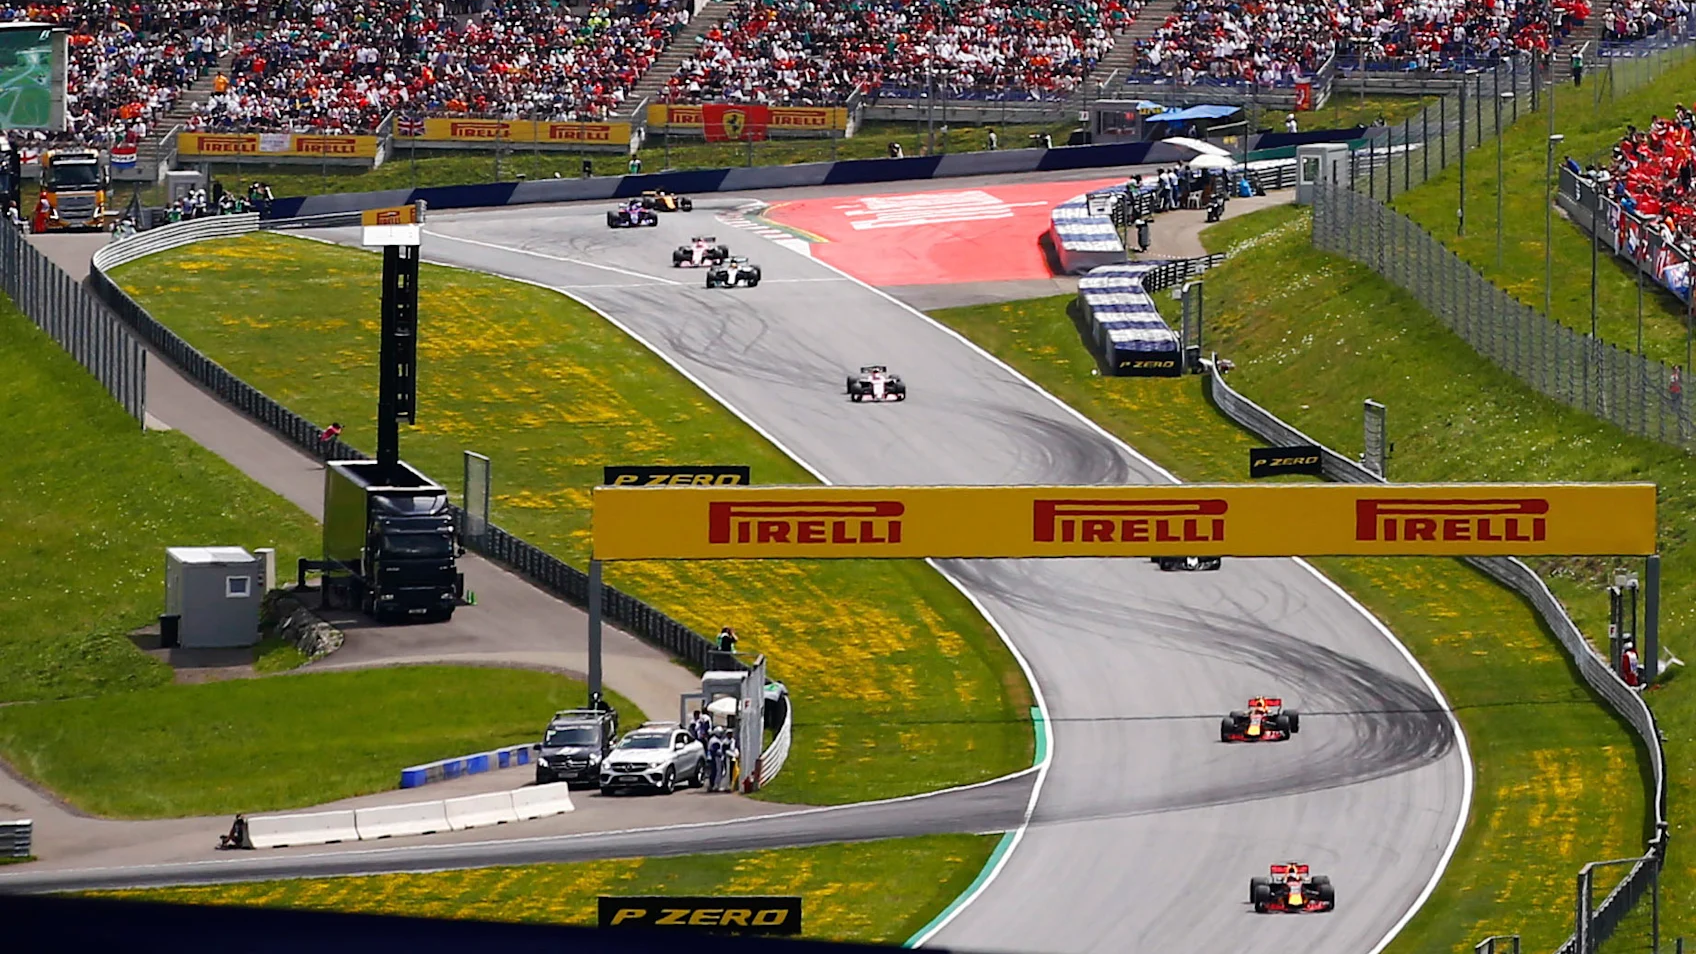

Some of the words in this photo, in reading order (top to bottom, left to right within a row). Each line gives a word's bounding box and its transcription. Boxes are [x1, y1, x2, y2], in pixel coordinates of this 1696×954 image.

[451, 122, 510, 138] PIRELLI
[550, 124, 610, 141] PIRELLI
[197, 136, 257, 152] PIRELLI
[296, 138, 356, 153] PIRELLI
[1120, 361, 1131, 369] P
[1132, 360, 1175, 369] ZERO
[1254, 459, 1266, 468] P
[1269, 455, 1319, 467] ZERO
[614, 474, 639, 486] P
[645, 474, 741, 486] ZERO
[708, 501, 905, 544] PIRELLI
[1033, 499, 1229, 543] PIRELLI
[1356, 498, 1550, 542] PIRELLI
[610, 908, 647, 926] P
[655, 909, 789, 926] ZERO
